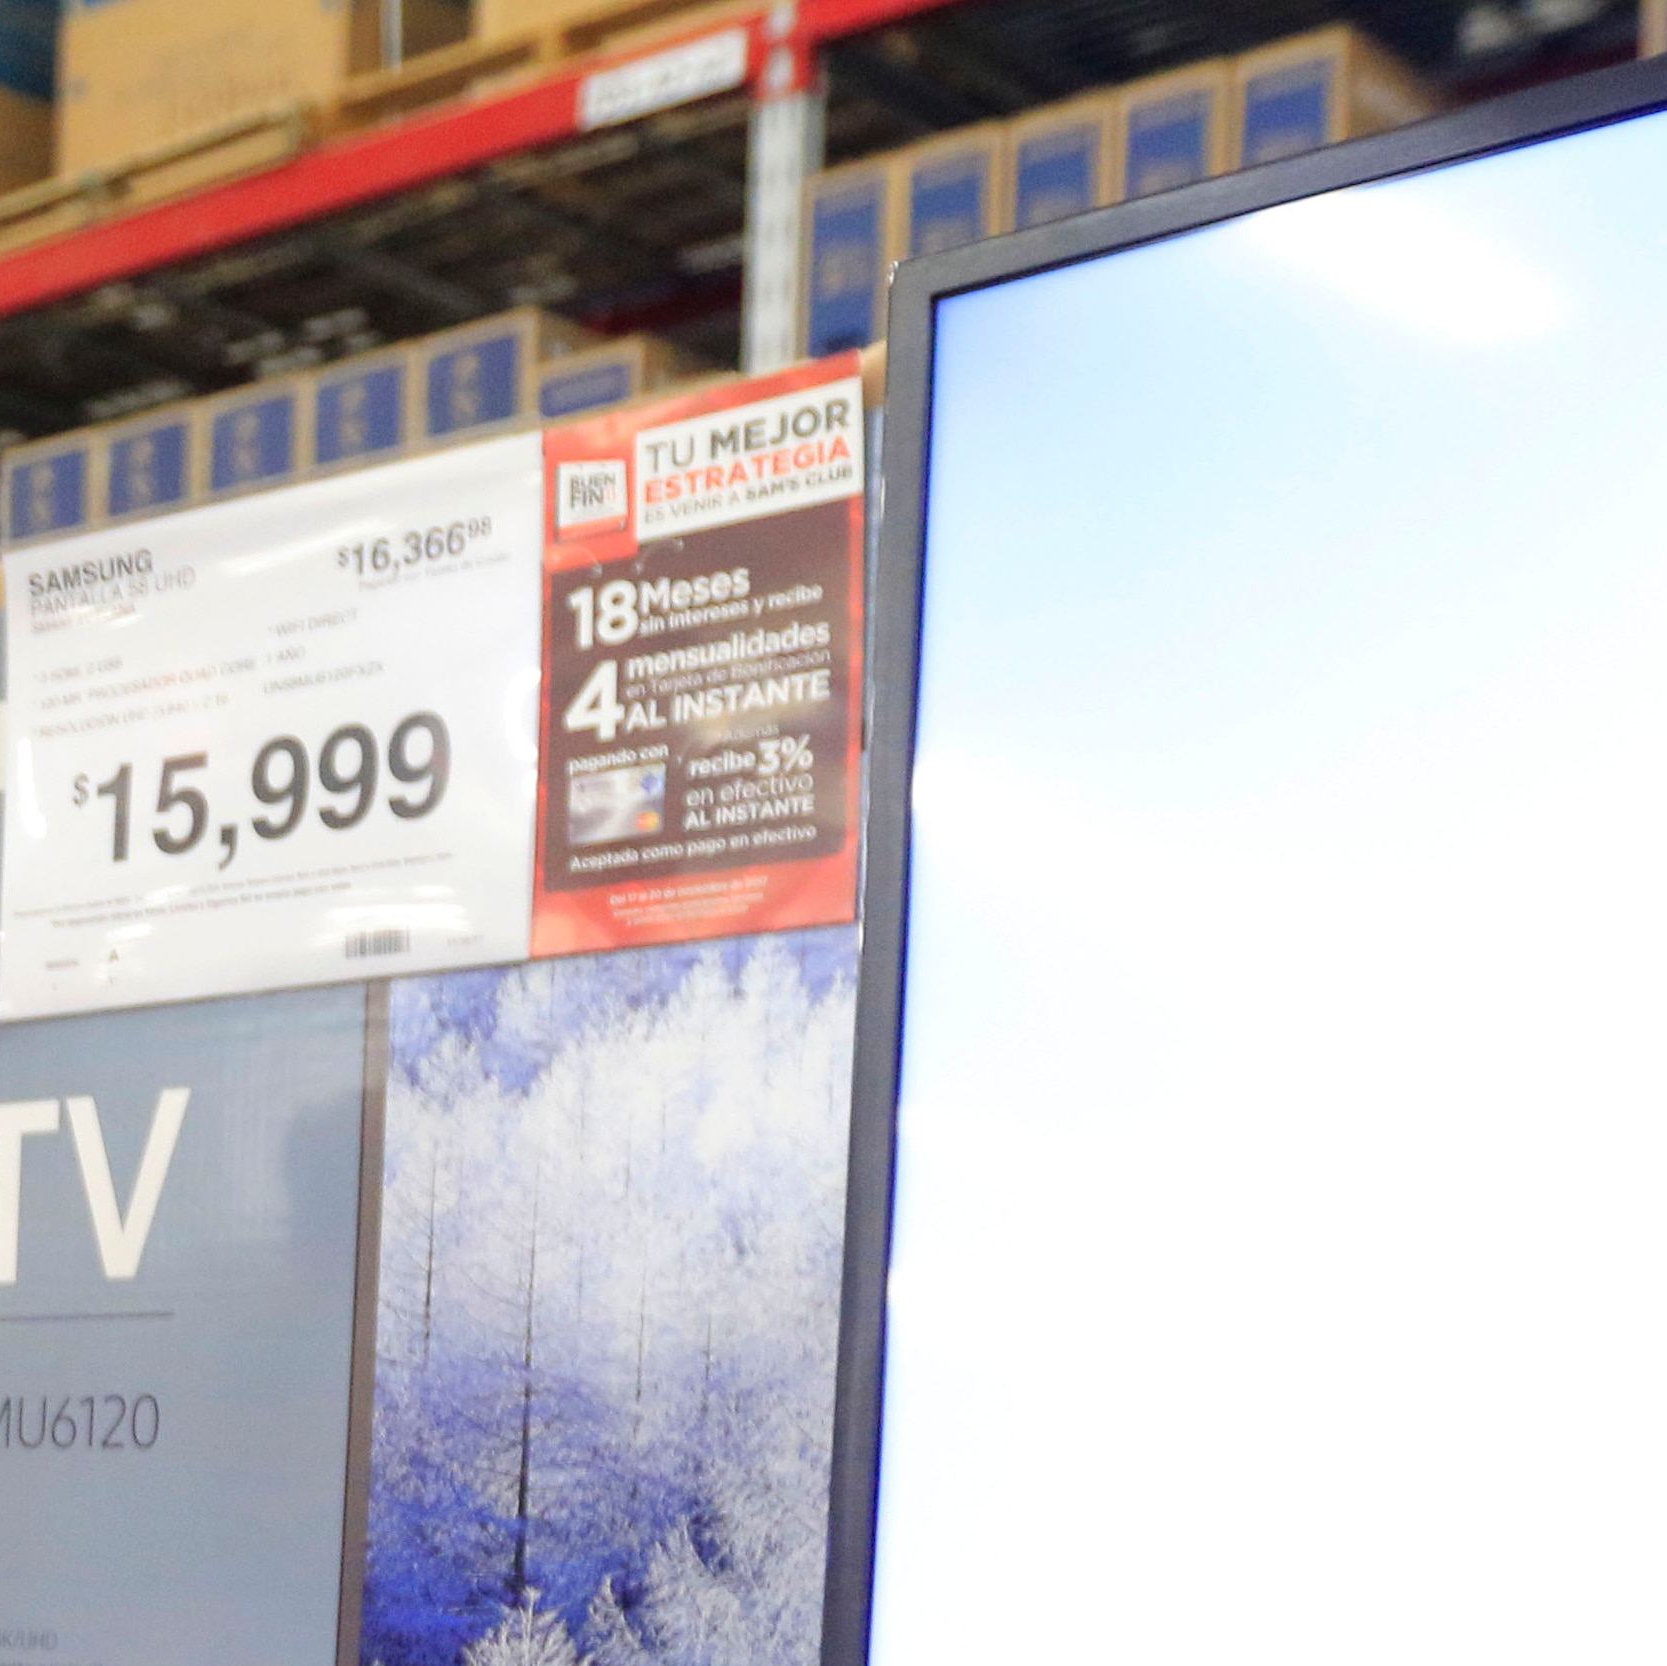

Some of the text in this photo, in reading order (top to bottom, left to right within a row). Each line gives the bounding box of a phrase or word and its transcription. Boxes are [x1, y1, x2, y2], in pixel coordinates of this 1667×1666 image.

[645, 398, 851, 473] TU MEJOR
[570, 472, 616, 493] BUEN
[644, 436, 851, 504] ESTRATEGIA
[645, 464, 854, 524] ES VENIR A SAM'S CLUB
[28, 548, 154, 597] SAMSUNG
[30, 583, 124, 617] PANTALLA
[155, 564, 197, 593] UHD
[567, 566, 751, 650] 18 Meses
[639, 583, 824, 638] sin intereses y recibe
[563, 620, 831, 743] 4 mensualidades
[625, 668, 831, 732] AL INSTANTE
[707, 665, 727, 684] de
[569, 744, 669, 775] pagando con
[689, 733, 814, 778] recibe 3%
[73, 709, 452, 871] $15,999
[684, 794, 815, 832] AL INSTANTE
[685, 772, 814, 808] en efectivo
[570, 824, 817, 874] Aceptada como pago en efectivo
